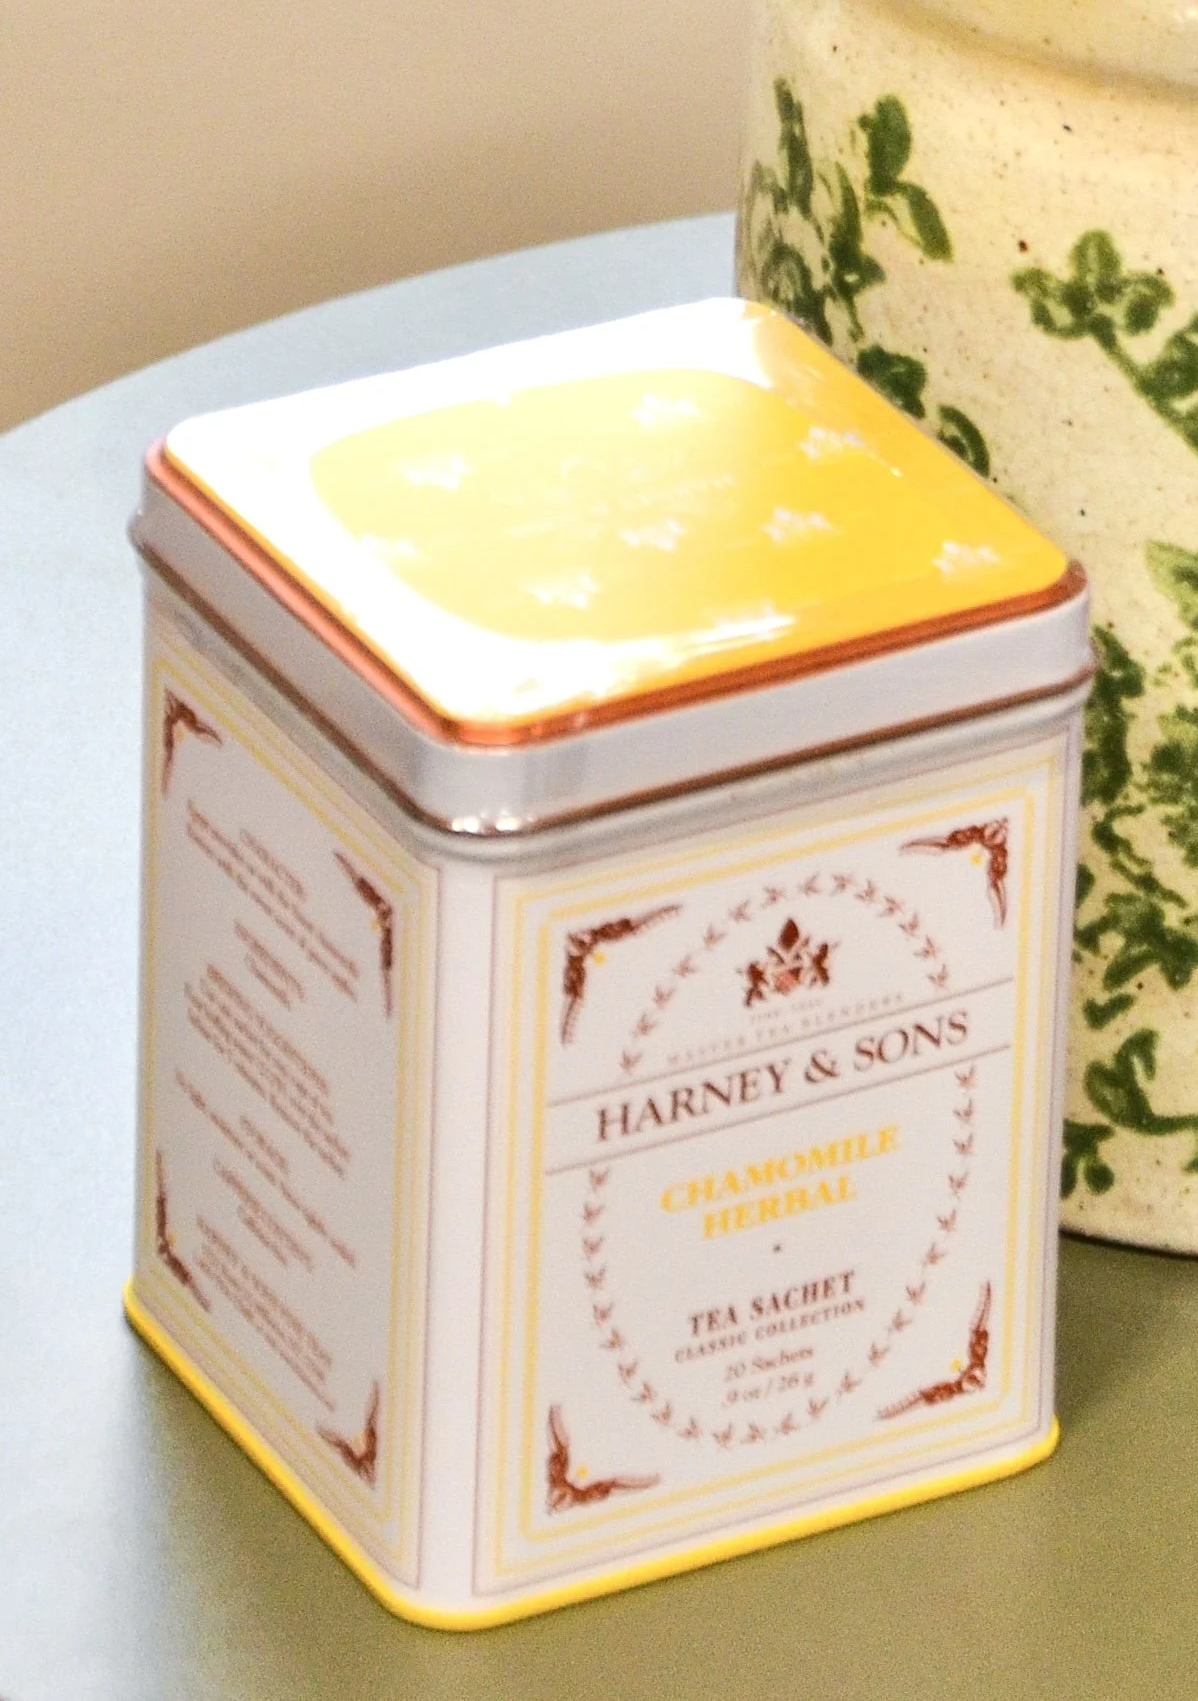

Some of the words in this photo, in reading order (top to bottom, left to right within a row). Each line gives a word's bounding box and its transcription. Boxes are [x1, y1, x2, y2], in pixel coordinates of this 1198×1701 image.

[596, 1056, 792, 1141] HARNEY
[804, 1048, 841, 1084] &
[853, 1010, 970, 1072] SONS
[660, 1124, 899, 1214] CHAMOMILE
[702, 1174, 857, 1241] HERBAL
[674, 1330, 748, 1364] CLASSIC
[754, 1298, 866, 1341] COLLECTION
[688, 1303, 739, 1338] TEA
[749, 1269, 855, 1320] SACHET
